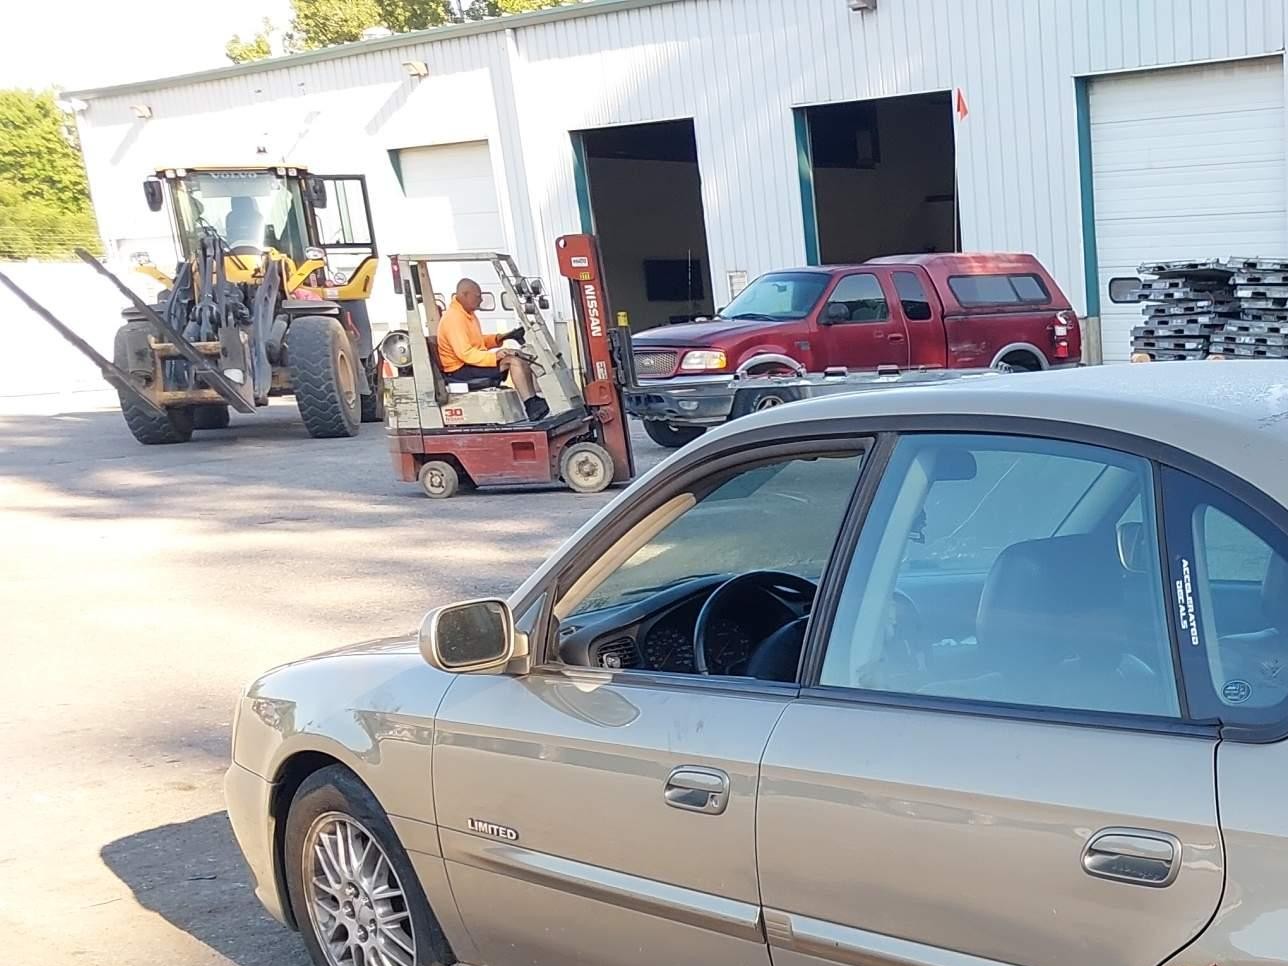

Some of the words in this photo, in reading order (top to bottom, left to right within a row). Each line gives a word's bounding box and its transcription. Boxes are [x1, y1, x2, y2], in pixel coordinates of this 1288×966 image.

[584, 284, 602, 337] NISSAN
[445, 408, 463, 417] 30
[1176, 580, 1189, 629] DECALS
[467, 818, 518, 840] LIMITED
